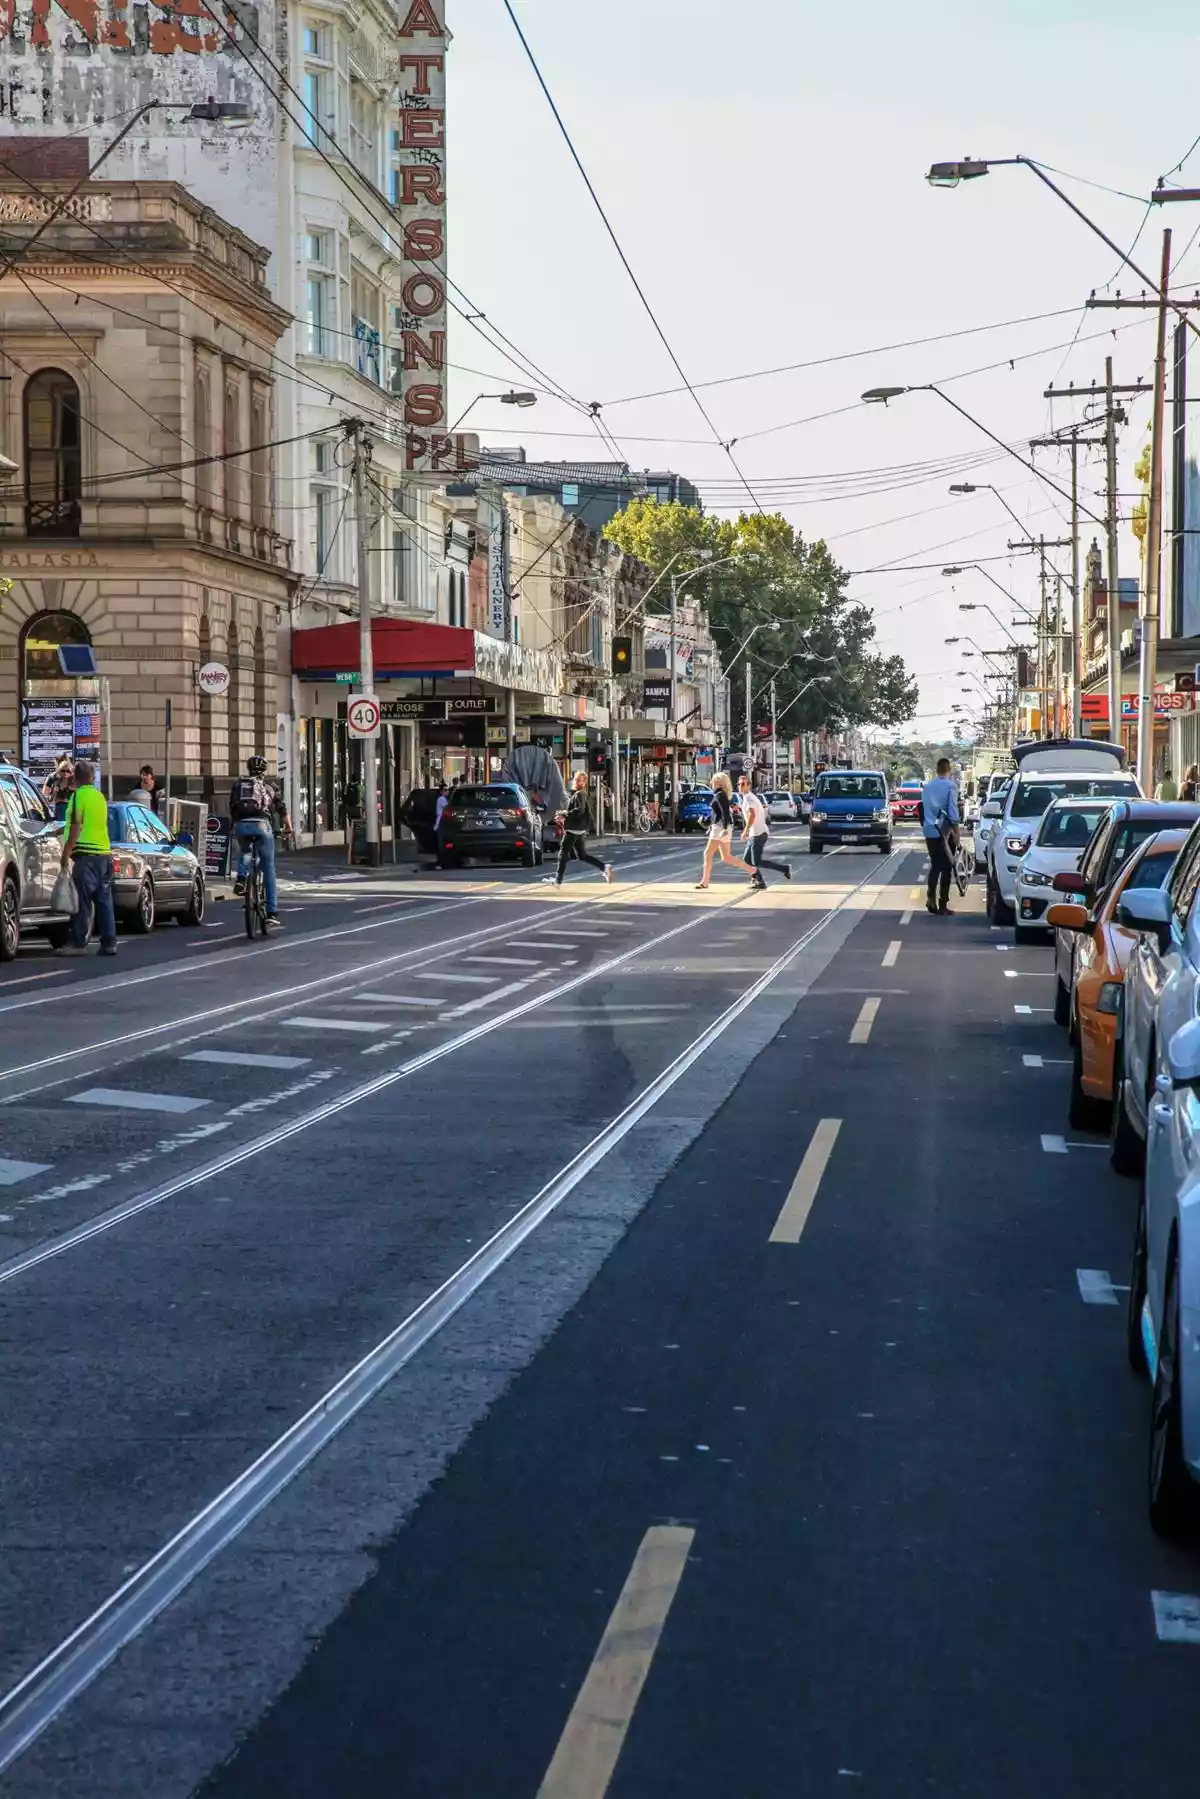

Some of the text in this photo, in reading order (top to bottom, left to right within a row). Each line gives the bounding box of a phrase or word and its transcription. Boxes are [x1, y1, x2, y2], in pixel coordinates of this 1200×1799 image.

[0, 552, 110, 572] ALASIA,
[492, 546, 504, 629] STATIONERY
[336, 672, 353, 681] WEBB
[645, 687, 670, 696] SAMPLE
[396, 703, 424, 712] ROSE
[454, 700, 487, 709] OUTLET
[354, 708, 375, 724] 40
